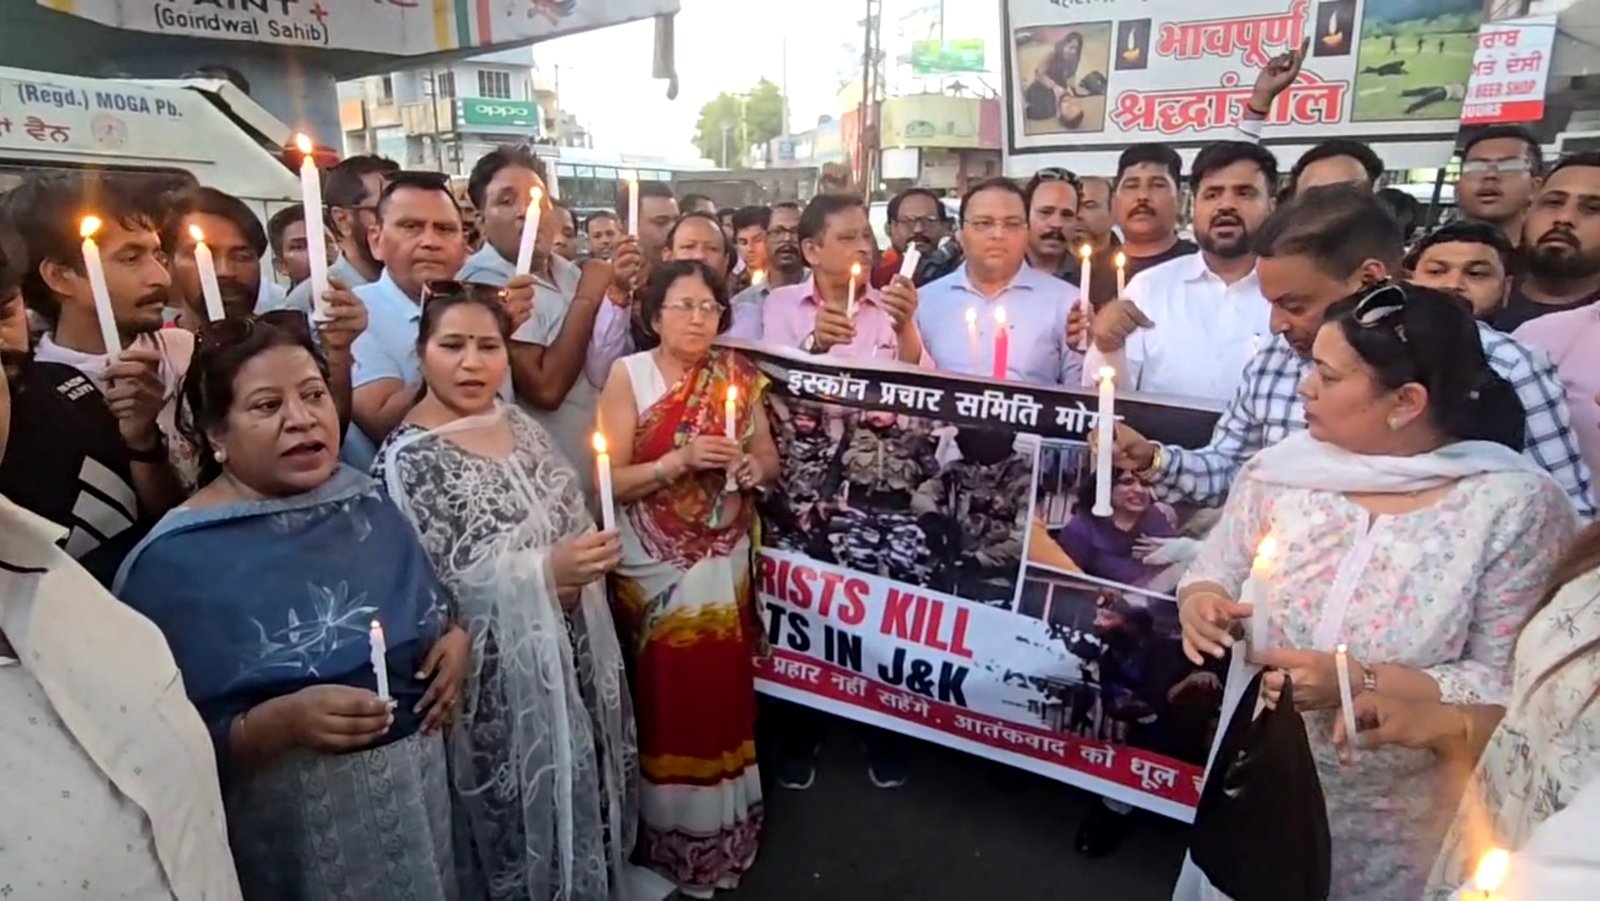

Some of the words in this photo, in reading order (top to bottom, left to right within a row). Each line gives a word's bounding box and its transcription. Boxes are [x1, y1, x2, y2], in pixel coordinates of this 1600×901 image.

[155, 3, 259, 35] (Goindwal
[268, 19, 329, 45] Sahib)
[1157, 0, 1310, 67] भावपूर्ण
[1476, 29, 1521, 49] ਰਾਬ
[18, 83, 90, 111] (Regd.)
[95, 92, 151, 114] MOGA
[156, 98, 183, 117] Pb.
[24, 115, 72, 144] ਵੈਨ
[787, 369, 869, 401] इस्कॉन
[879, 381, 944, 412] प्रचार
[954, 390, 1044, 427] समिति
[880, 587, 974, 659] KILL
[824, 624, 863, 673] IN
[877, 646, 970, 708] J&K
[773, 656, 822, 684] प्रहार
[830, 672, 869, 697] नहीं
[953, 713, 1068, 757] आतंकवाद
[1079, 744, 1117, 769] को
[1130, 756, 1180, 790] धूल
